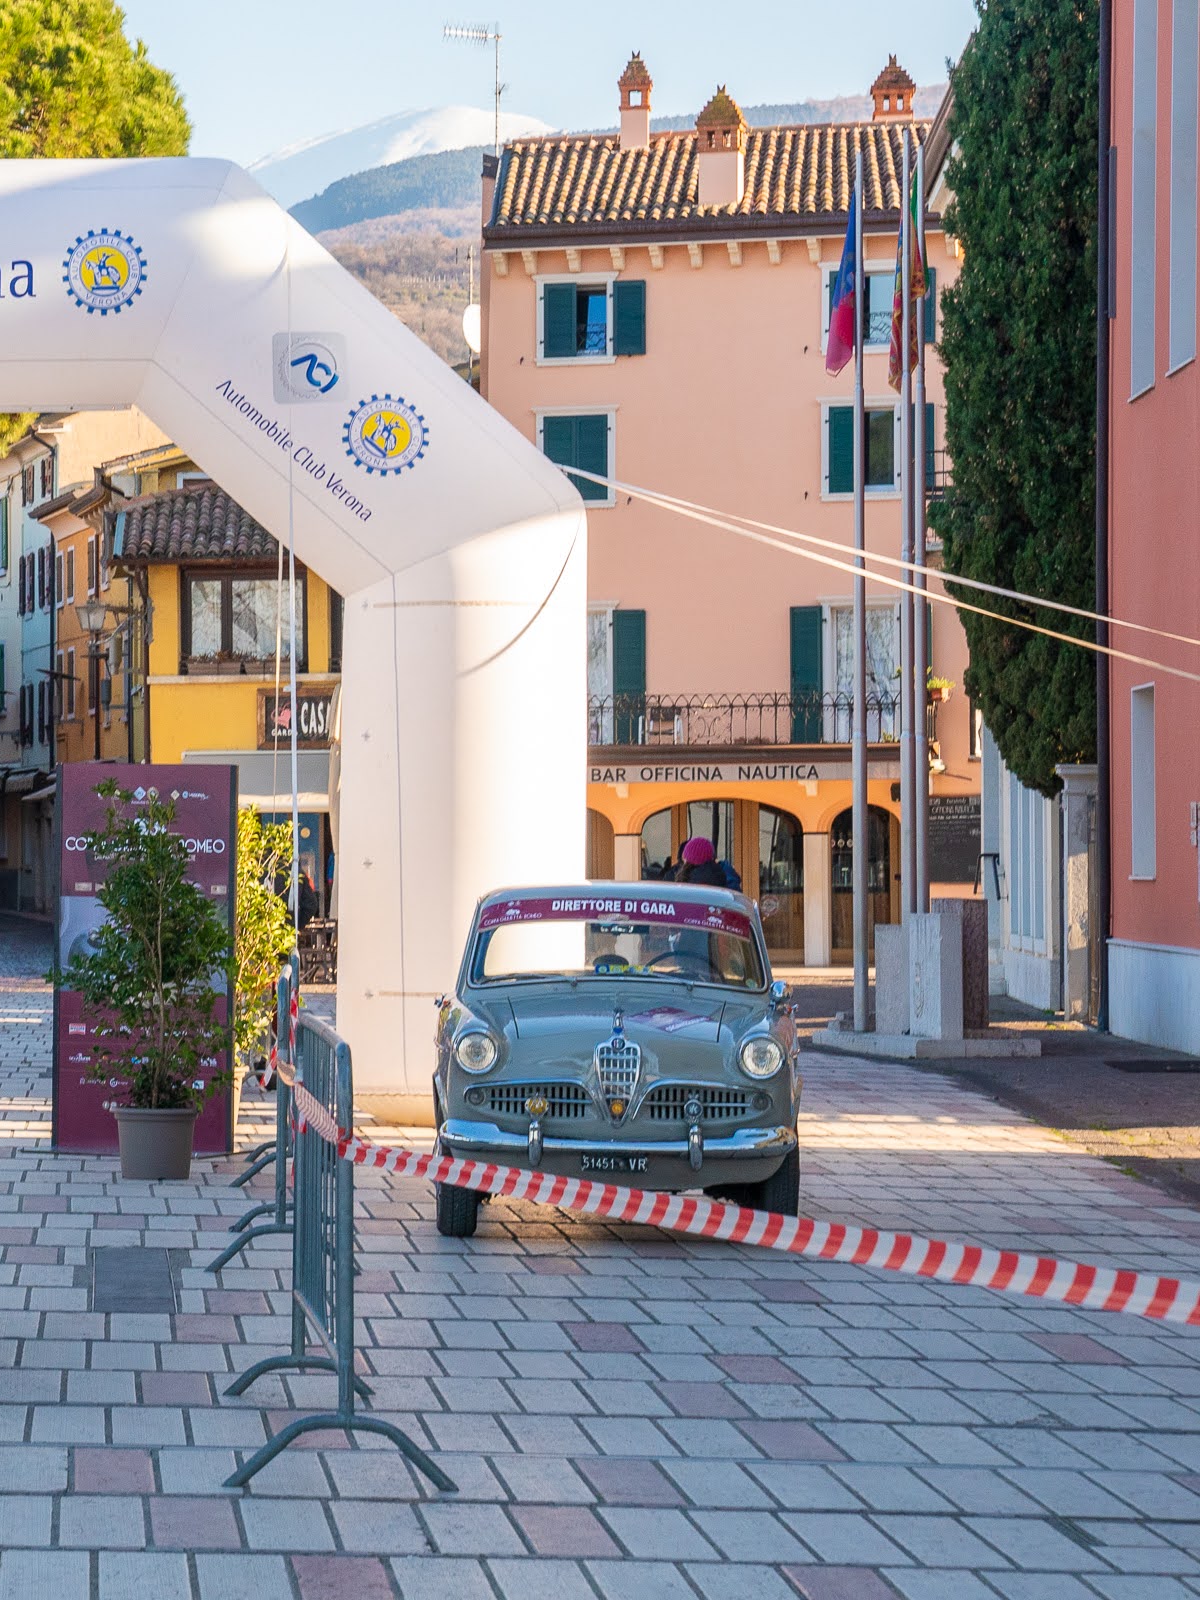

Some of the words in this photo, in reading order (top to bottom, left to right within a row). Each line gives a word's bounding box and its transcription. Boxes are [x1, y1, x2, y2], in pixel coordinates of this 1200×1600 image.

[215, 379, 294, 452] Automobile
[293, 446, 326, 480] Club
[326, 472, 373, 522] Verona
[271, 728, 298, 737] GARD
[591, 768, 626, 782] BAR
[640, 767, 723, 782] OFFICINA
[738, 765, 820, 781] NAUTICA
[551, 899, 622, 912] DIRETTORE
[624, 901, 637, 913] DI
[640, 902, 676, 916] GARA
[583, 1155, 616, 1168] 51451
[628, 1156, 648, 1171] VR
